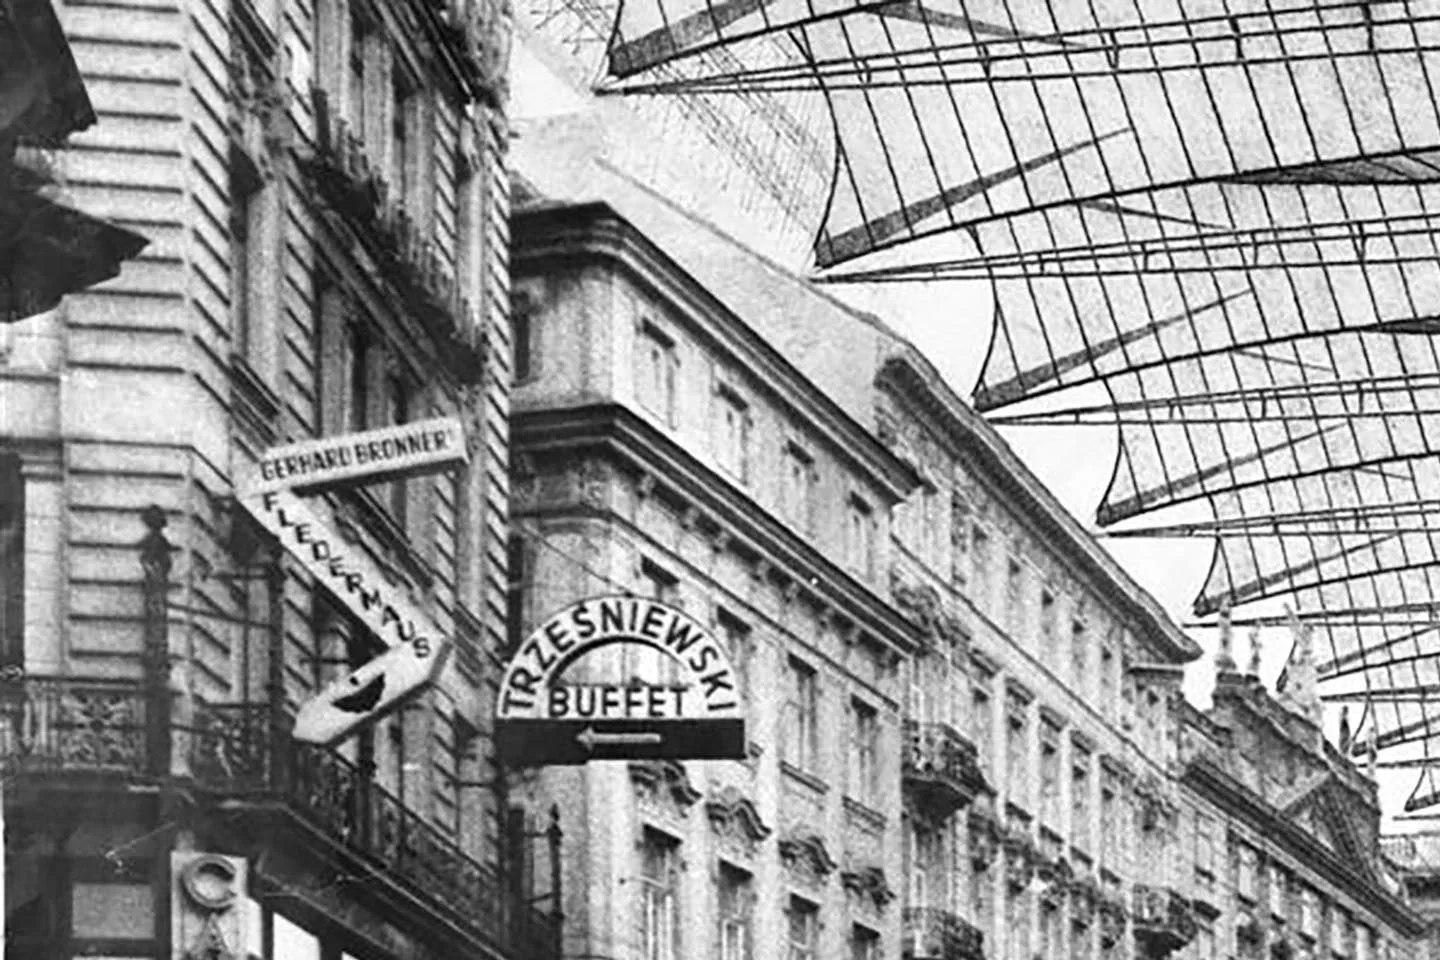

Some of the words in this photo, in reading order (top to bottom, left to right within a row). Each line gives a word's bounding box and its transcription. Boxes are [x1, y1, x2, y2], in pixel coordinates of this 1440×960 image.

[260, 449, 351, 482] GERHARD
[262, 491, 431, 659] FLEDERMAUS
[549, 686, 689, 718] BUFFET
